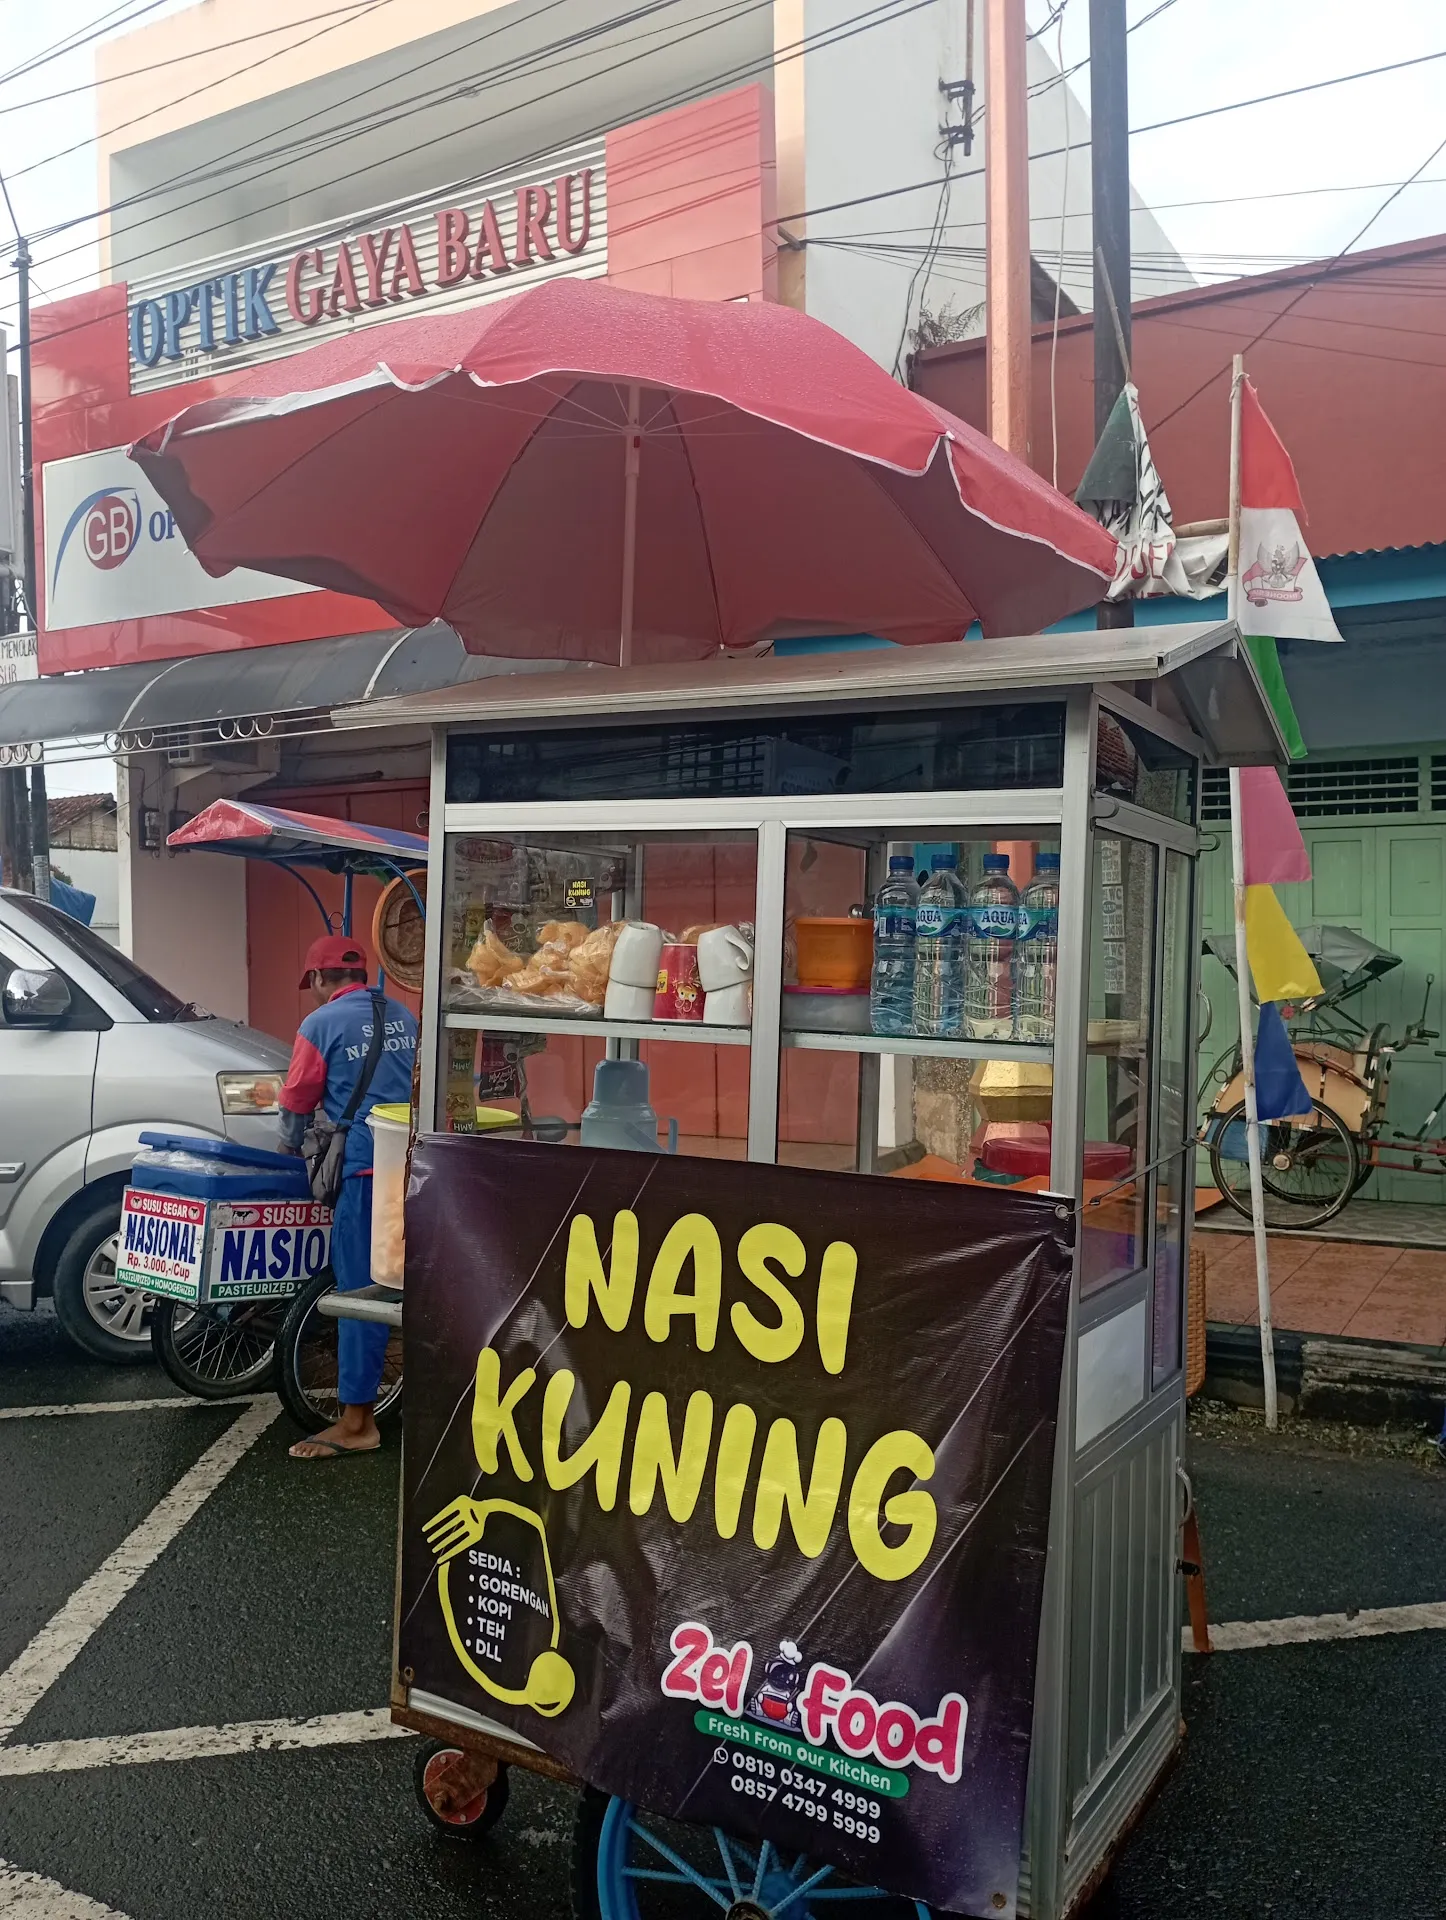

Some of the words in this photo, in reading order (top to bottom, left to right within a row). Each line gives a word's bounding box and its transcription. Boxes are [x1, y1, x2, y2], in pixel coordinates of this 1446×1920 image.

[130, 263, 281, 367] OPTIK
[286, 223, 427, 325] GAYA
[435, 168, 594, 288] BARU
[84, 506, 131, 561] GB
[149, 509, 177, 542] OP
[981, 910, 1015, 925] AQUA
[361, 1021, 405, 1037] SSU
[142, 1198, 162, 1213] SUSU
[162, 1203, 188, 1218] SEGAR
[262, 1206, 306, 1225] SUSU
[124, 1213, 197, 1265] NASIONAL
[220, 1228, 334, 1282] NASIO
[127, 1252, 140, 1270] Rp.
[118, 1271, 151, 1286] PASTEURIZED
[154, 1279, 196, 1297] HOMOGENIZED
[218, 1282, 295, 1297] PASTEURIZED
[564, 1209, 858, 1375] NASI
[471, 1346, 938, 1581] KUNING
[468, 1549, 513, 1576] SEDIA
[477, 1594, 512, 1620] KOPI
[478, 1574, 550, 1618] GORENGAN
[476, 1615, 506, 1641] TEH
[475, 1638, 502, 1663] DLL
[663, 1625, 751, 1714] Zel
[708, 1717, 750, 1742] Fresh
[754, 1731, 793, 1756] From
[829, 1759, 891, 1791] Kitchen
[732, 1751, 776, 1779] 0819
[780, 1768, 827, 1798] 0347
[831, 1788, 881, 1820] 4999
[730, 1774, 778, 1802] 0857
[782, 1792, 828, 1822] 4799
[833, 1811, 881, 1844] 5999
